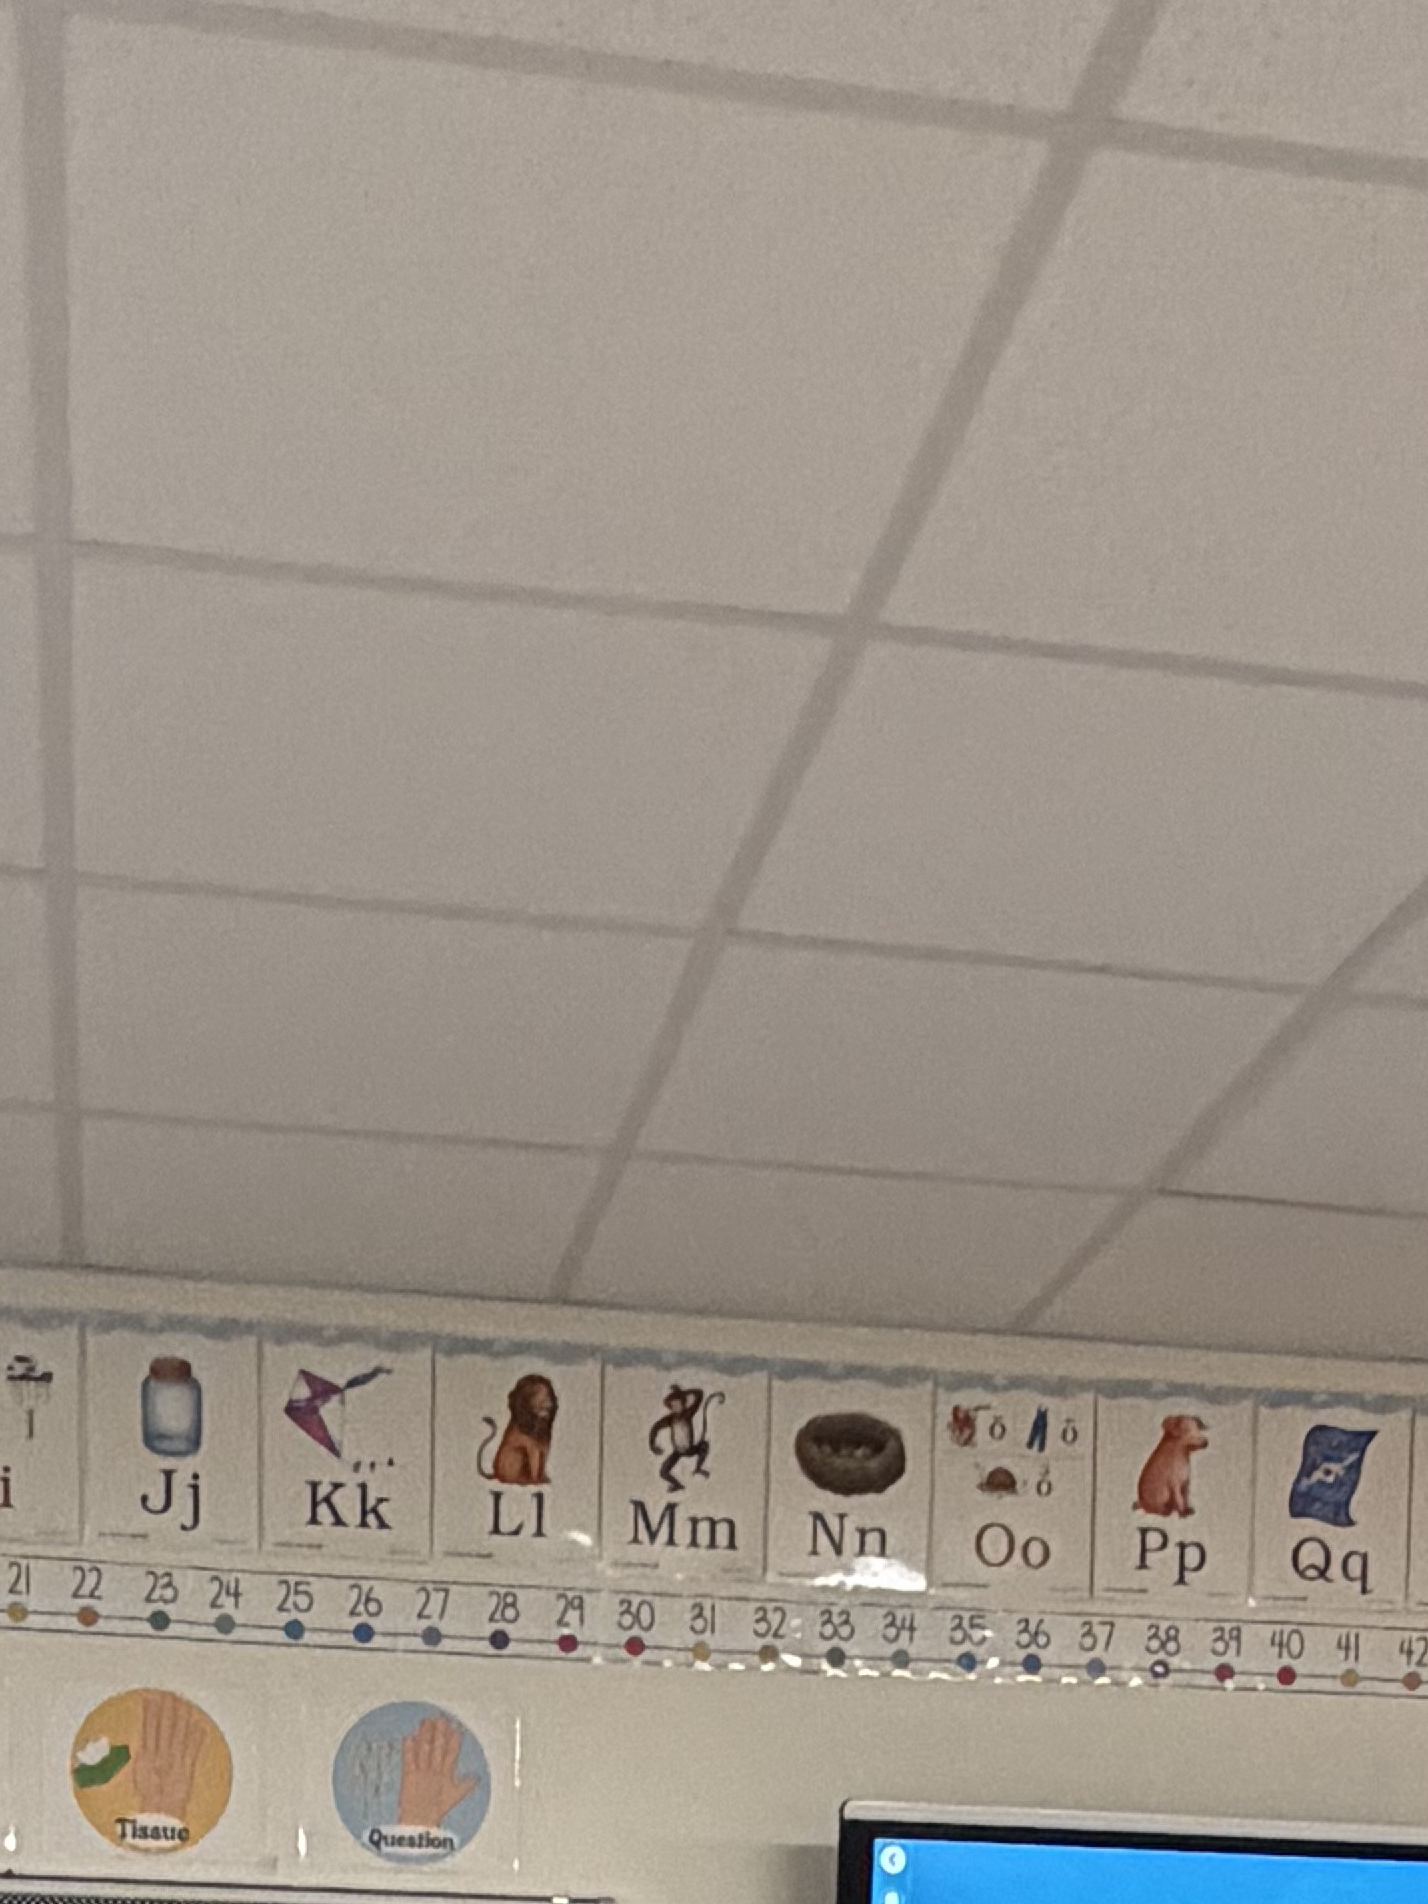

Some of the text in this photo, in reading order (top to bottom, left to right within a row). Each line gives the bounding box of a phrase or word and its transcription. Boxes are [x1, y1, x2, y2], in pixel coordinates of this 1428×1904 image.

[140, 1469, 202, 1531] Jj
[304, 1480, 391, 1530] Kk
[627, 1500, 738, 1550] Mm
[808, 1510, 887, 1558] Nn
[975, 1521, 1050, 1569] Oo
[1135, 1527, 1207, 1586] Pp
[1290, 1538, 1373, 1593] Qq
[8, 1562, 31, 1594] 21
[72, 1566, 102, 1599] 22
[144, 1571, 178, 1604] 23
[210, 1576, 243, 1608] 24
[277, 1581, 313, 1612] 25
[348, 1584, 382, 1616] 26
[416, 1587, 449, 1619] 27
[489, 1591, 519, 1623] 28
[556, 1594, 586, 1626] 29
[617, 1598, 656, 1631] 30
[689, 1604, 716, 1633] 31
[753, 1607, 786, 1638] 32
[819, 1610, 854, 1640] 33
[882, 1613, 917, 1643] 34
[949, 1615, 987, 1645] 35
[1016, 1617, 1050, 1648] 36
[1080, 1620, 1116, 1651] 37
[1145, 1622, 1180, 1655] 38
[1212, 1625, 1243, 1656] 39
[1271, 1628, 1304, 1659] 40
[1337, 1633, 1361, 1662] 41
[115, 1817, 190, 1844] Tissue
[368, 1827, 457, 1854] Question
